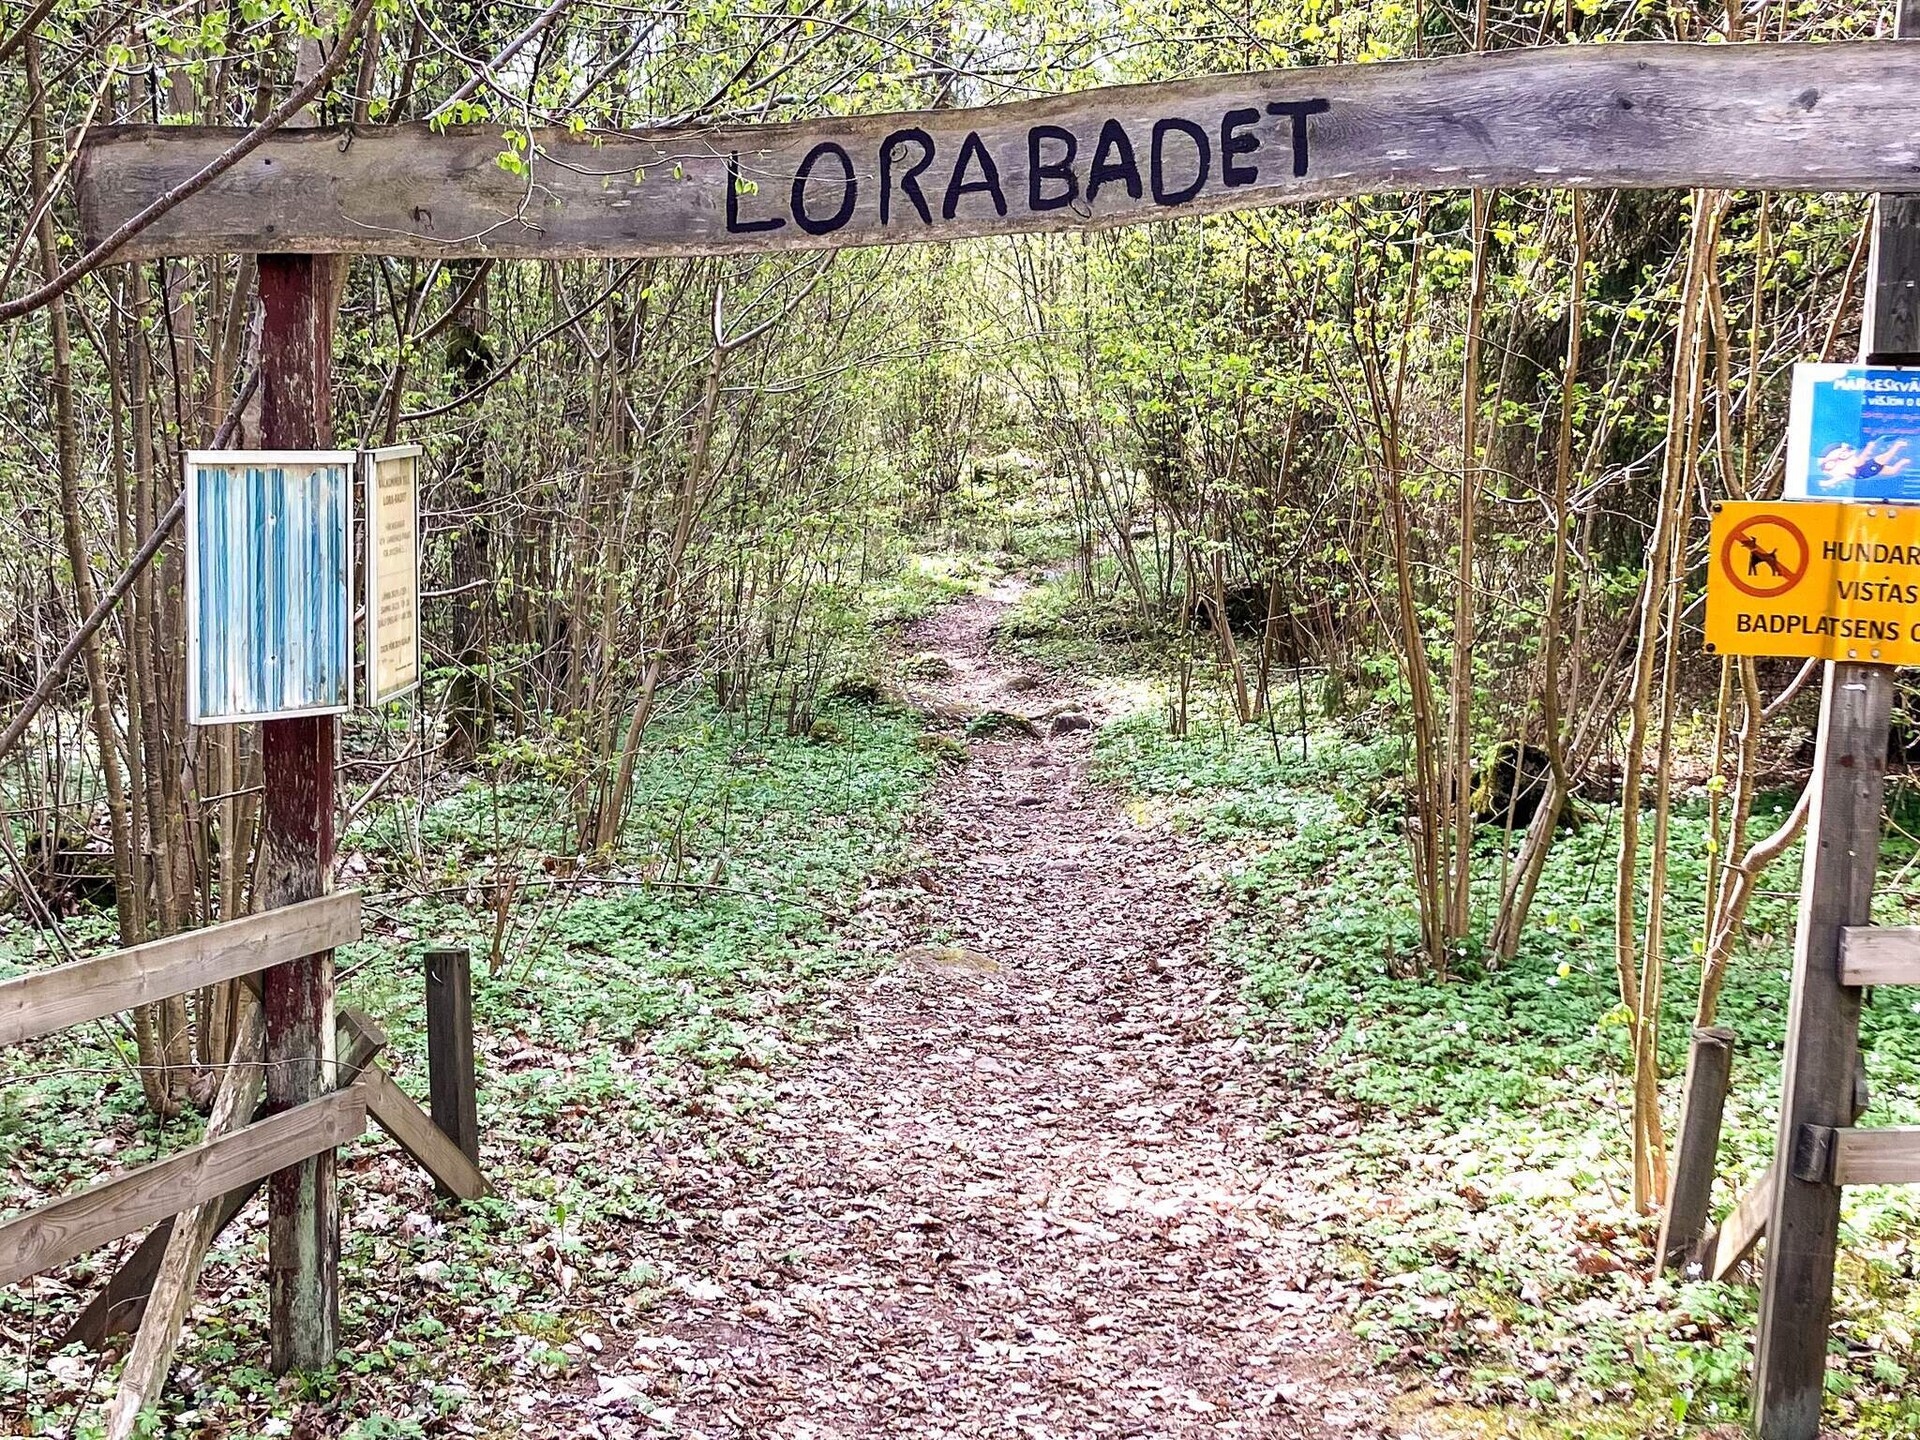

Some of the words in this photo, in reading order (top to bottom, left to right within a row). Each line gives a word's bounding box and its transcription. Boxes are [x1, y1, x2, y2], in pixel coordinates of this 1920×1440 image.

[725, 98, 1332, 235] LORABADET
[1822, 541, 1920, 565] HUNDAR
[1837, 580, 1918, 604] VISTAS
[1736, 613, 1900, 641] BADPLATSENS
